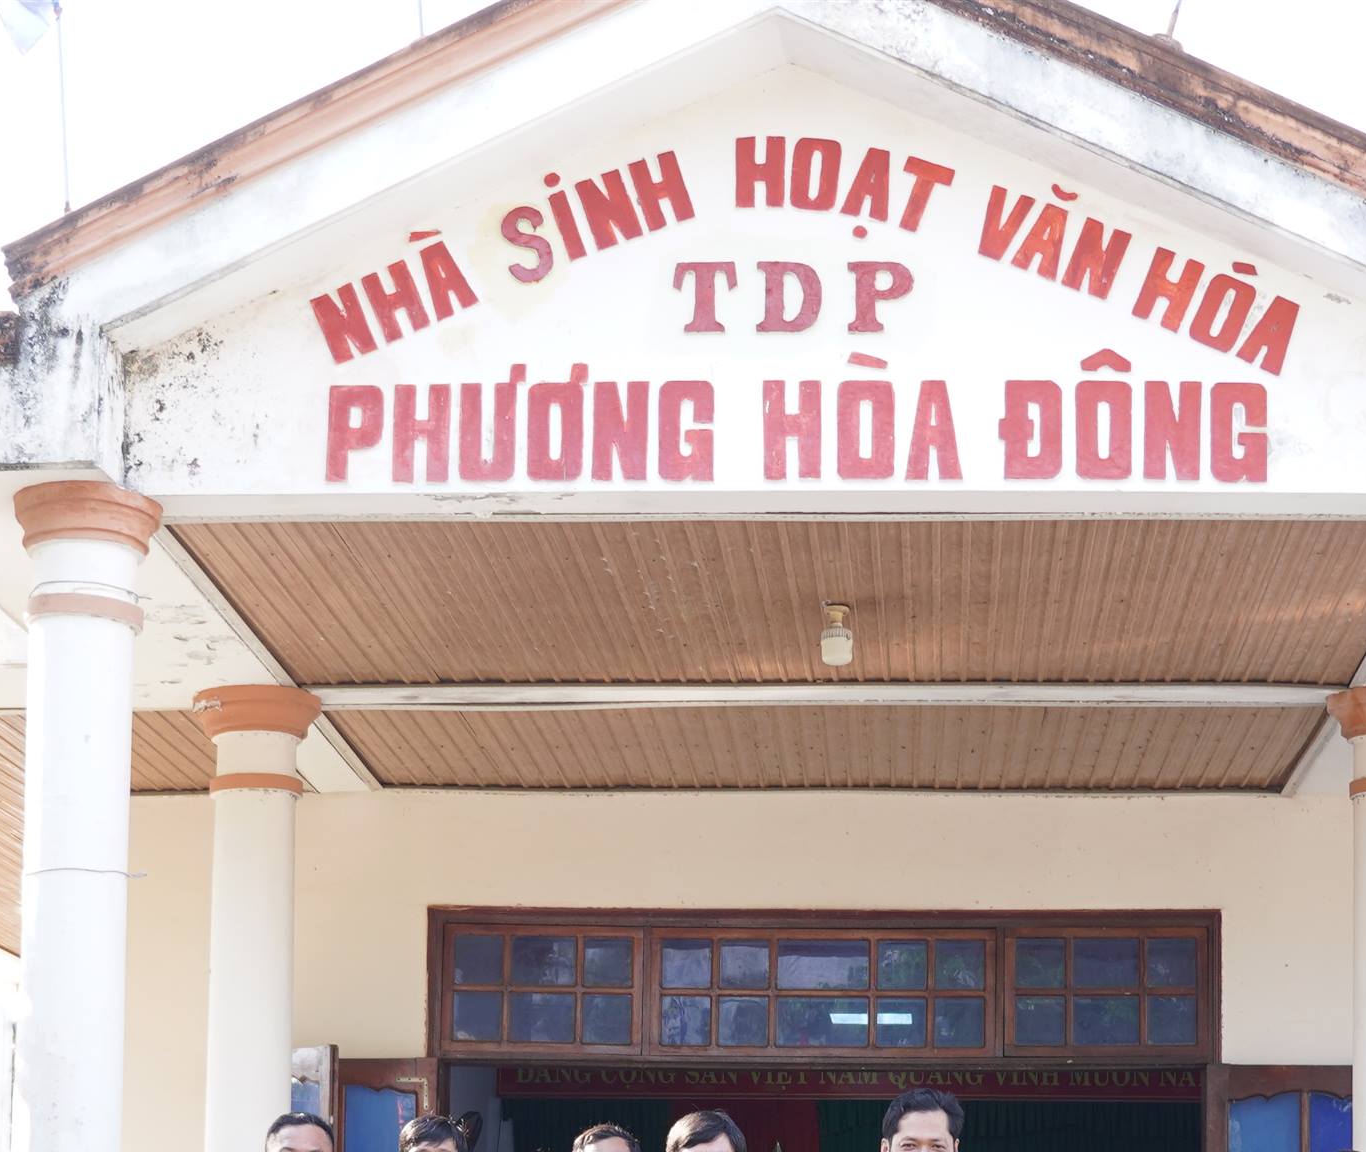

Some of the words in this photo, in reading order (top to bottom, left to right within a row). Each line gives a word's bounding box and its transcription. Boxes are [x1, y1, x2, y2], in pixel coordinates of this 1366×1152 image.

[309, 230, 479, 365] NHÀ
[734, 135, 956, 240] HOẠT
[978, 183, 1133, 301] VĂN
[1131, 246, 1301, 377] HÓA
[674, 261, 914, 334] TDP
[326, 363, 716, 483] PHƯƠNG
[762, 351, 963, 482] HÒA
[998, 347, 1270, 483] ĐÔNG
